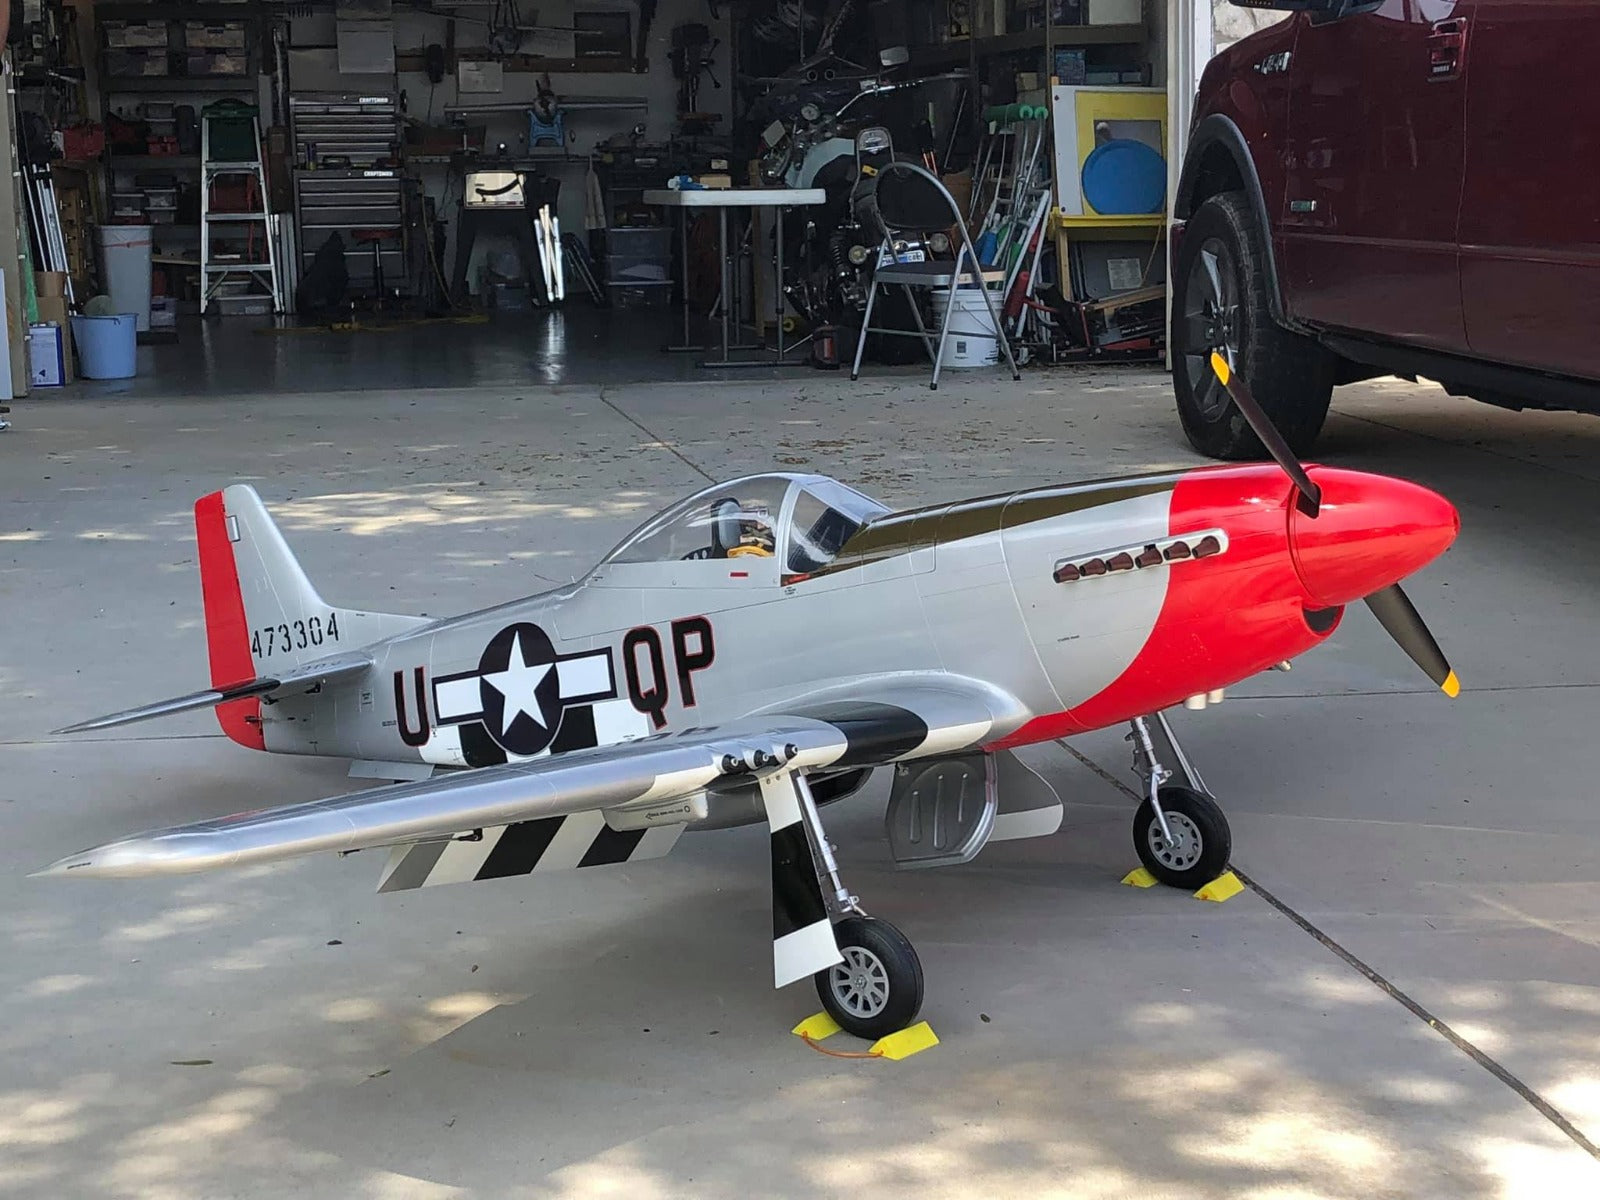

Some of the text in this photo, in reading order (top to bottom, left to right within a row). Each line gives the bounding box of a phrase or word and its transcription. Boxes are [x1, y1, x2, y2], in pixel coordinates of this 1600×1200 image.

[252, 612, 339, 659] 473304
[622, 614, 715, 730] QP
[394, 665, 430, 747] U
